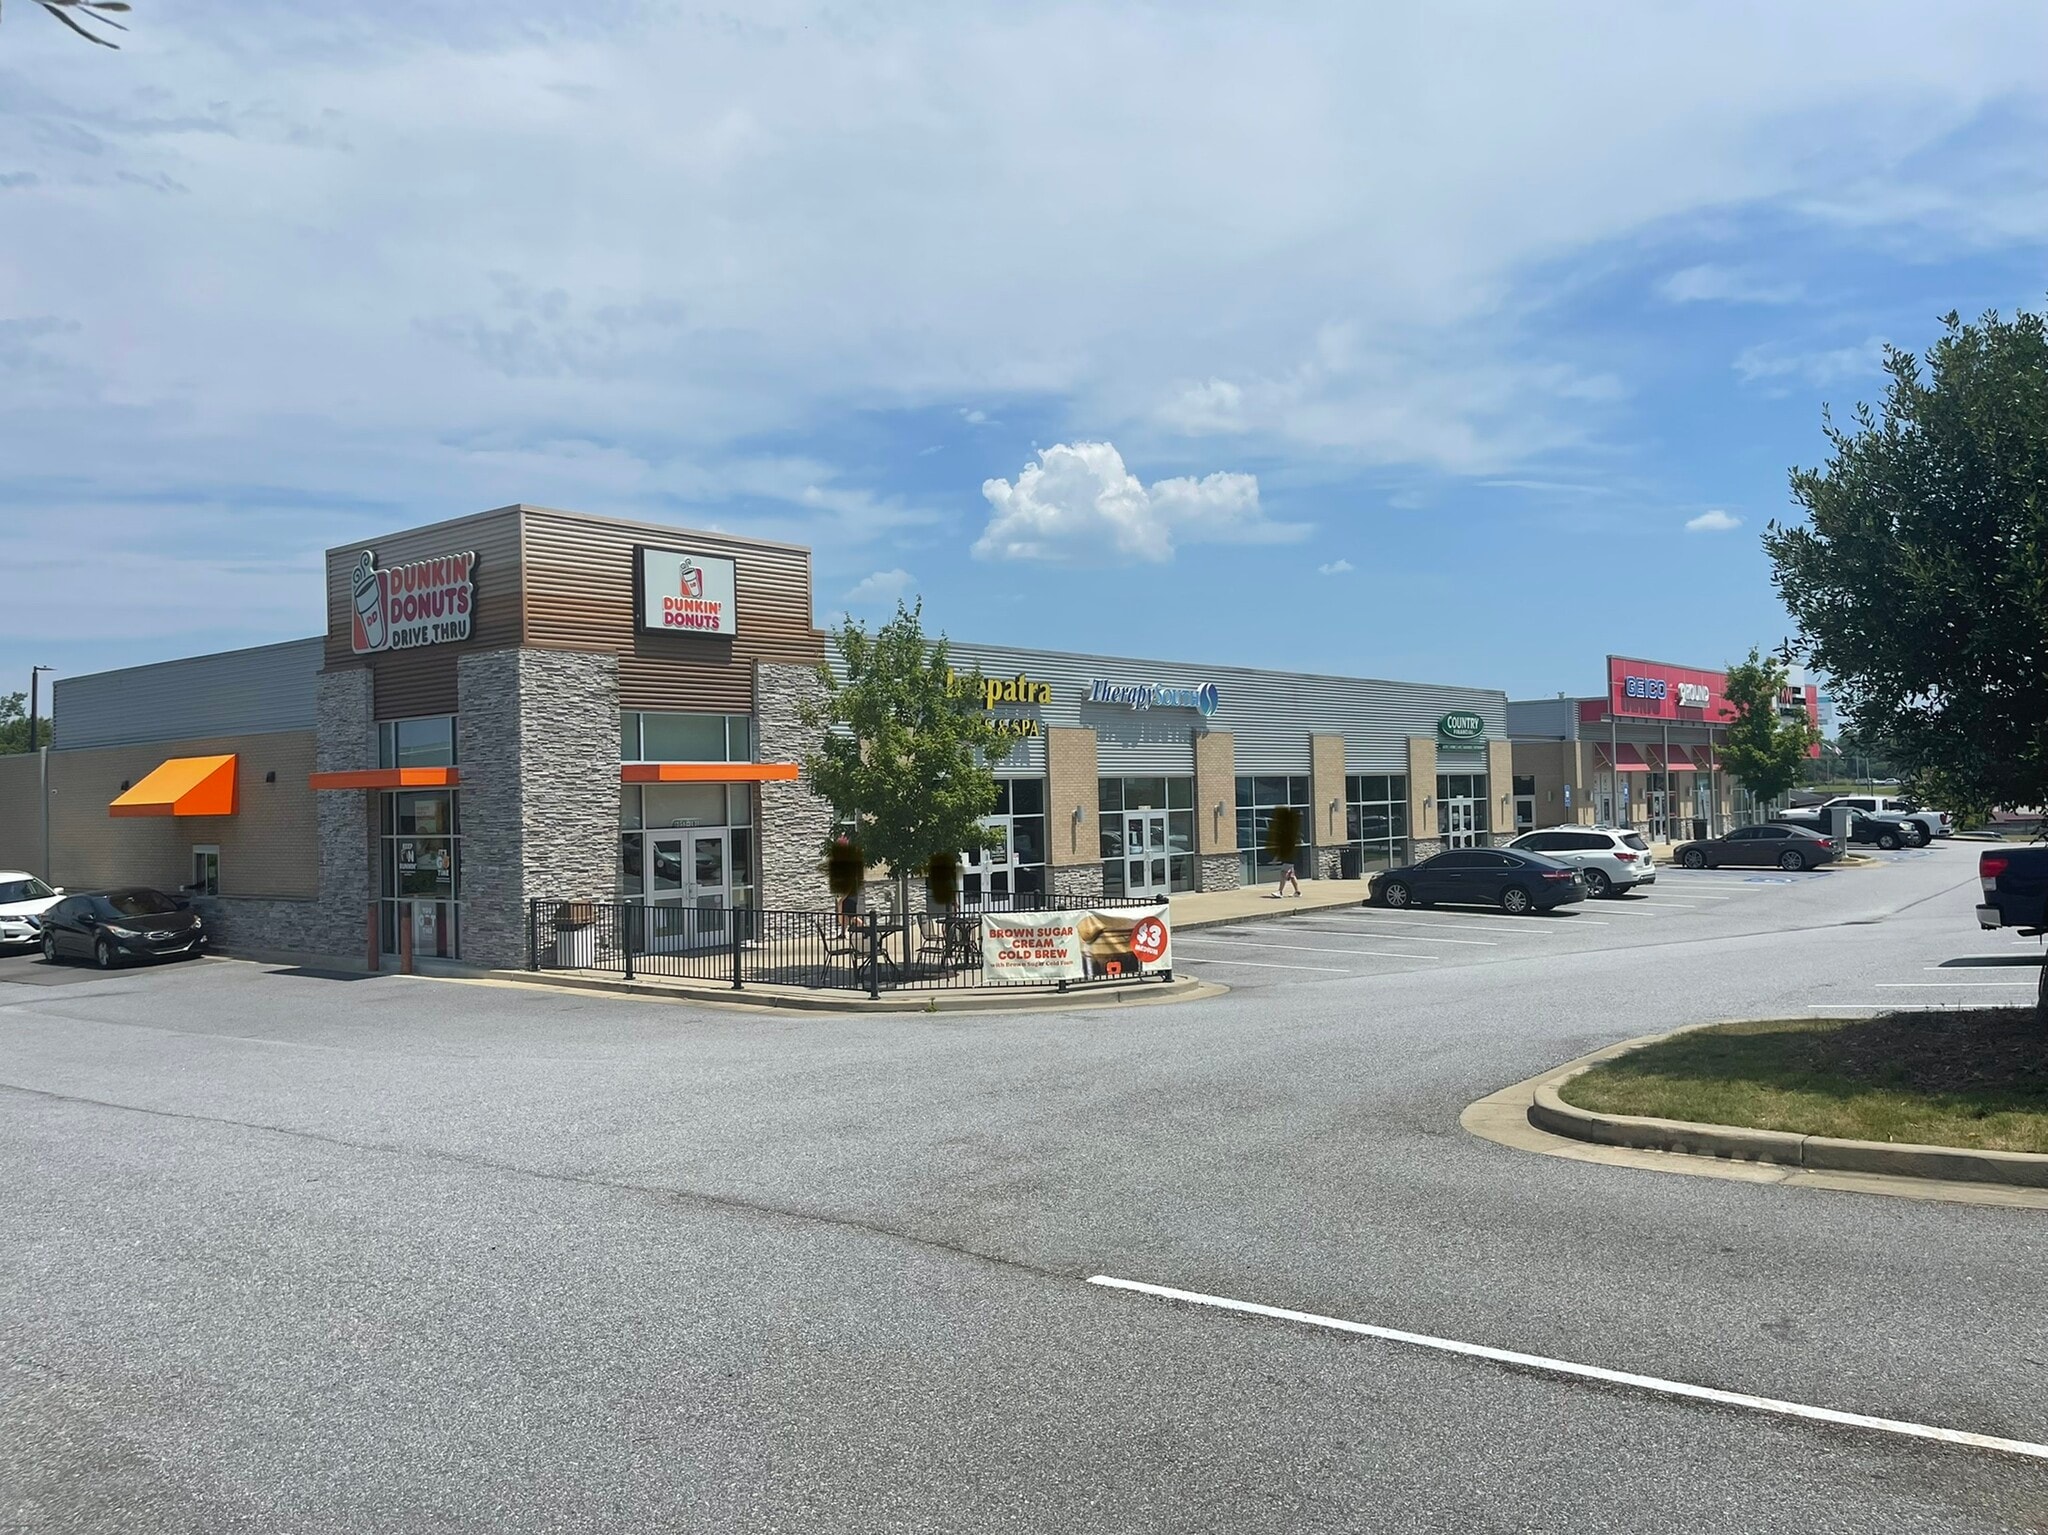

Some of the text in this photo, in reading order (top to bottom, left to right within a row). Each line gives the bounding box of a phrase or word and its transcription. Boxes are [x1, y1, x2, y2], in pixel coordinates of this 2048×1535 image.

[391, 553, 472, 596] DUNKIN'
[391, 585, 469, 624] DONUTS
[663, 597, 721, 614] DUNKIN'
[664, 611, 720, 629] DONUTS
[392, 620, 466, 647] DRIVE THRU
[1626, 675, 1667, 700] GEICO
[1012, 718, 1039, 737] SPA
[1447, 716, 1480, 729] COUNTRY
[989, 927, 1073, 938] BROWN SUGAR
[1136, 923, 1162, 947] $3
[1012, 938, 1054, 948] CREAM
[998, 949, 1067, 960] COLD BREW
